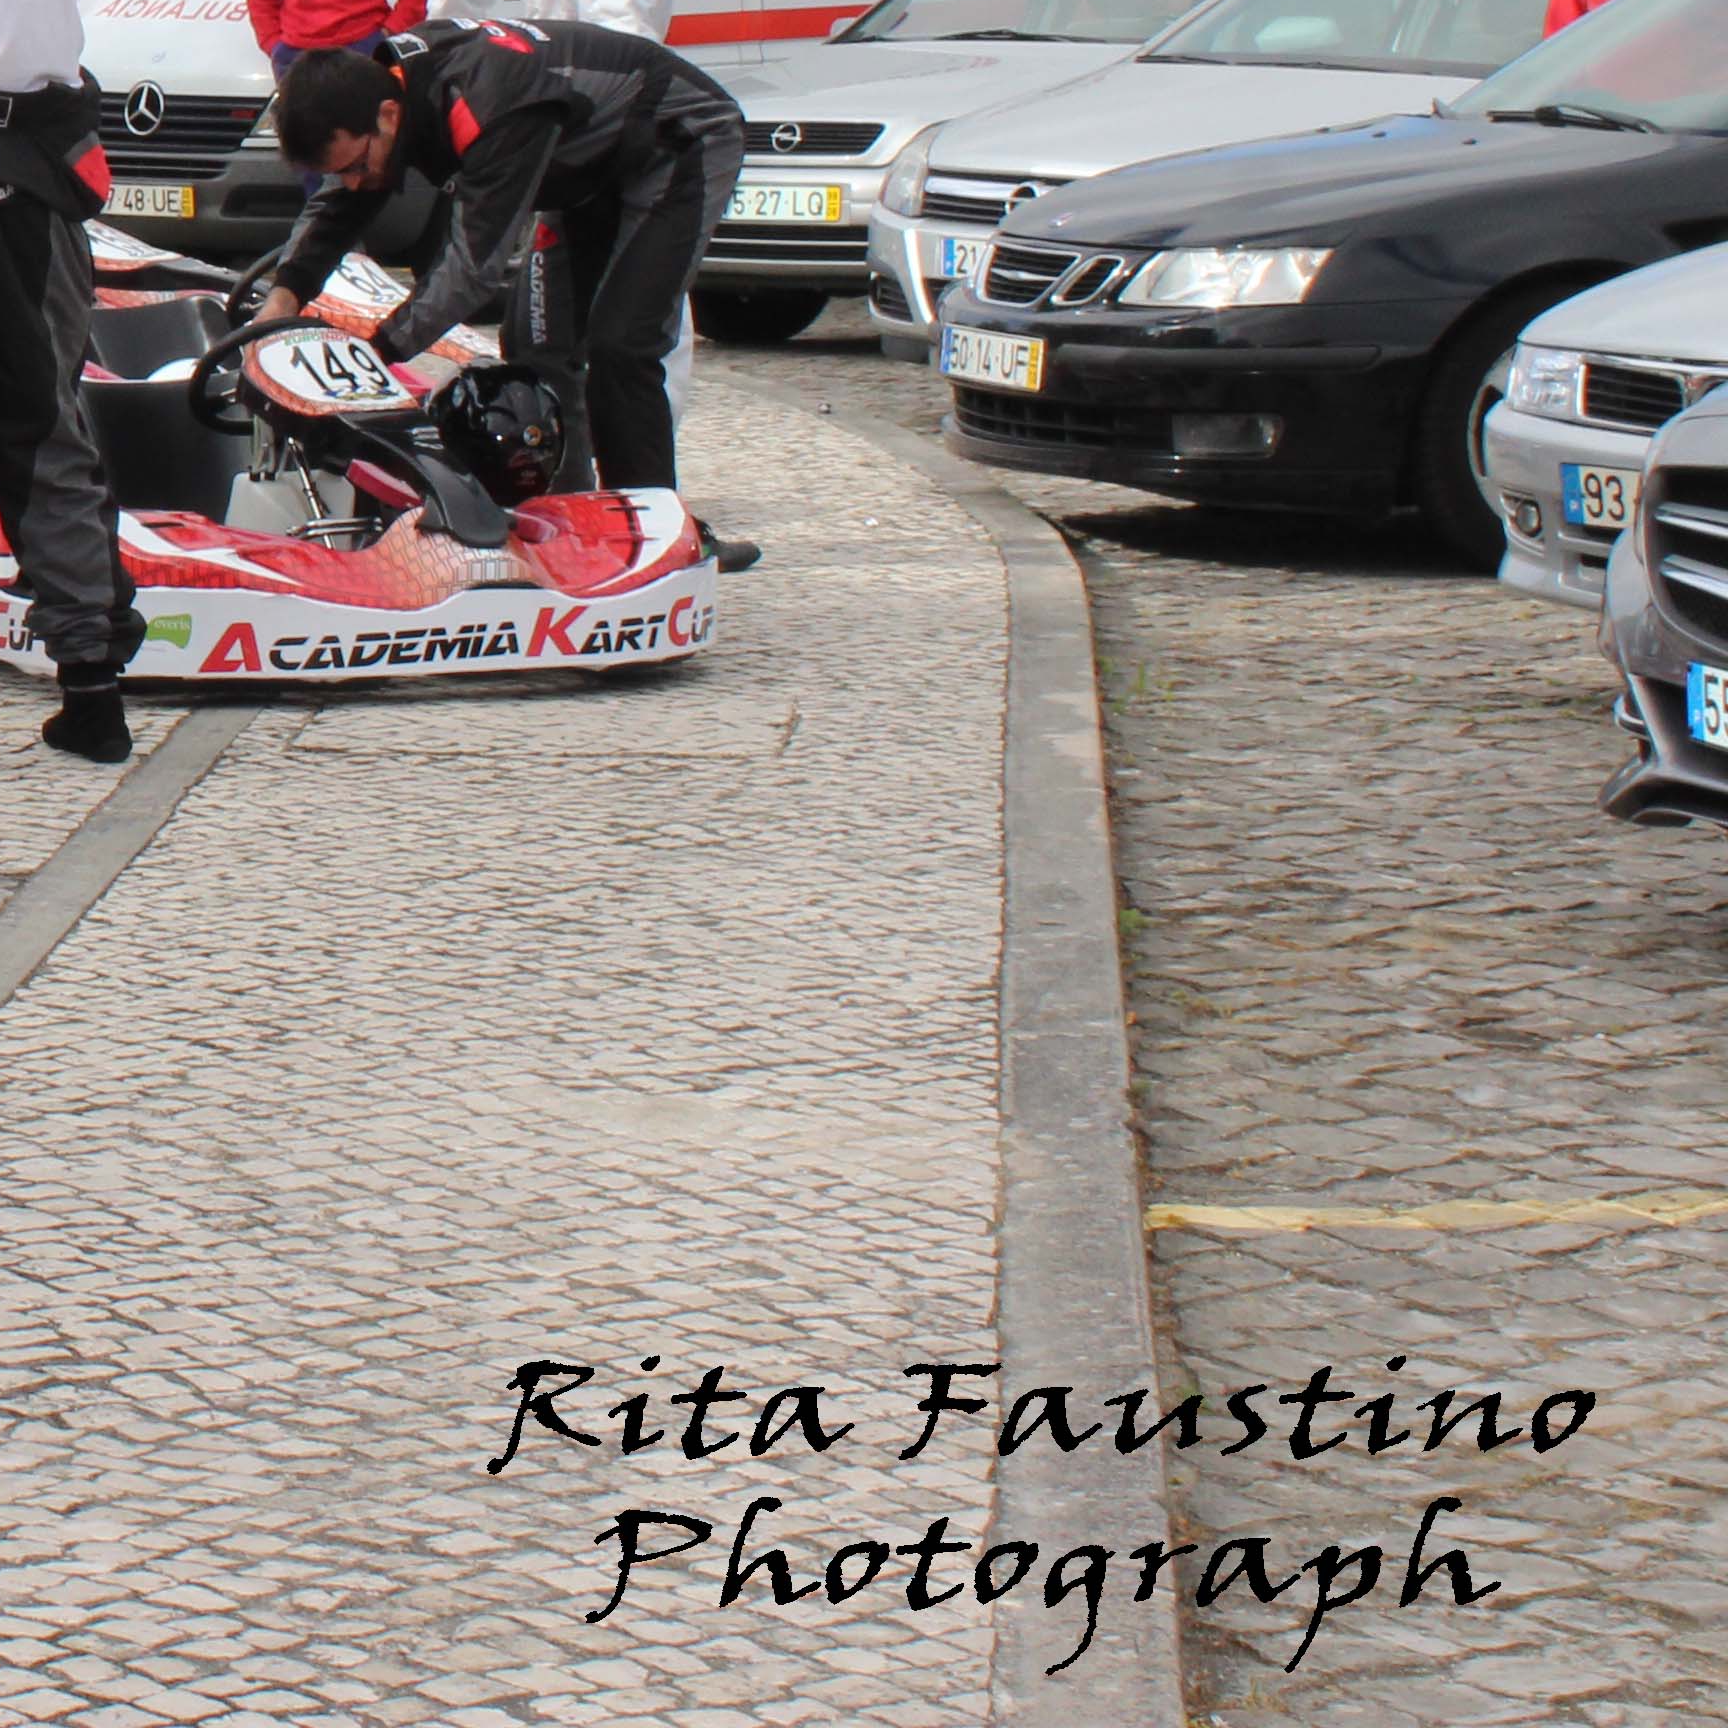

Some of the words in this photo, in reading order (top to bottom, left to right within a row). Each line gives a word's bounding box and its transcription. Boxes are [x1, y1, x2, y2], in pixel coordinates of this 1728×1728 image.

[733, 190, 825, 217] 5-27-LQ
[290, 341, 392, 392] 149
[525, 605, 667, 656] KART
